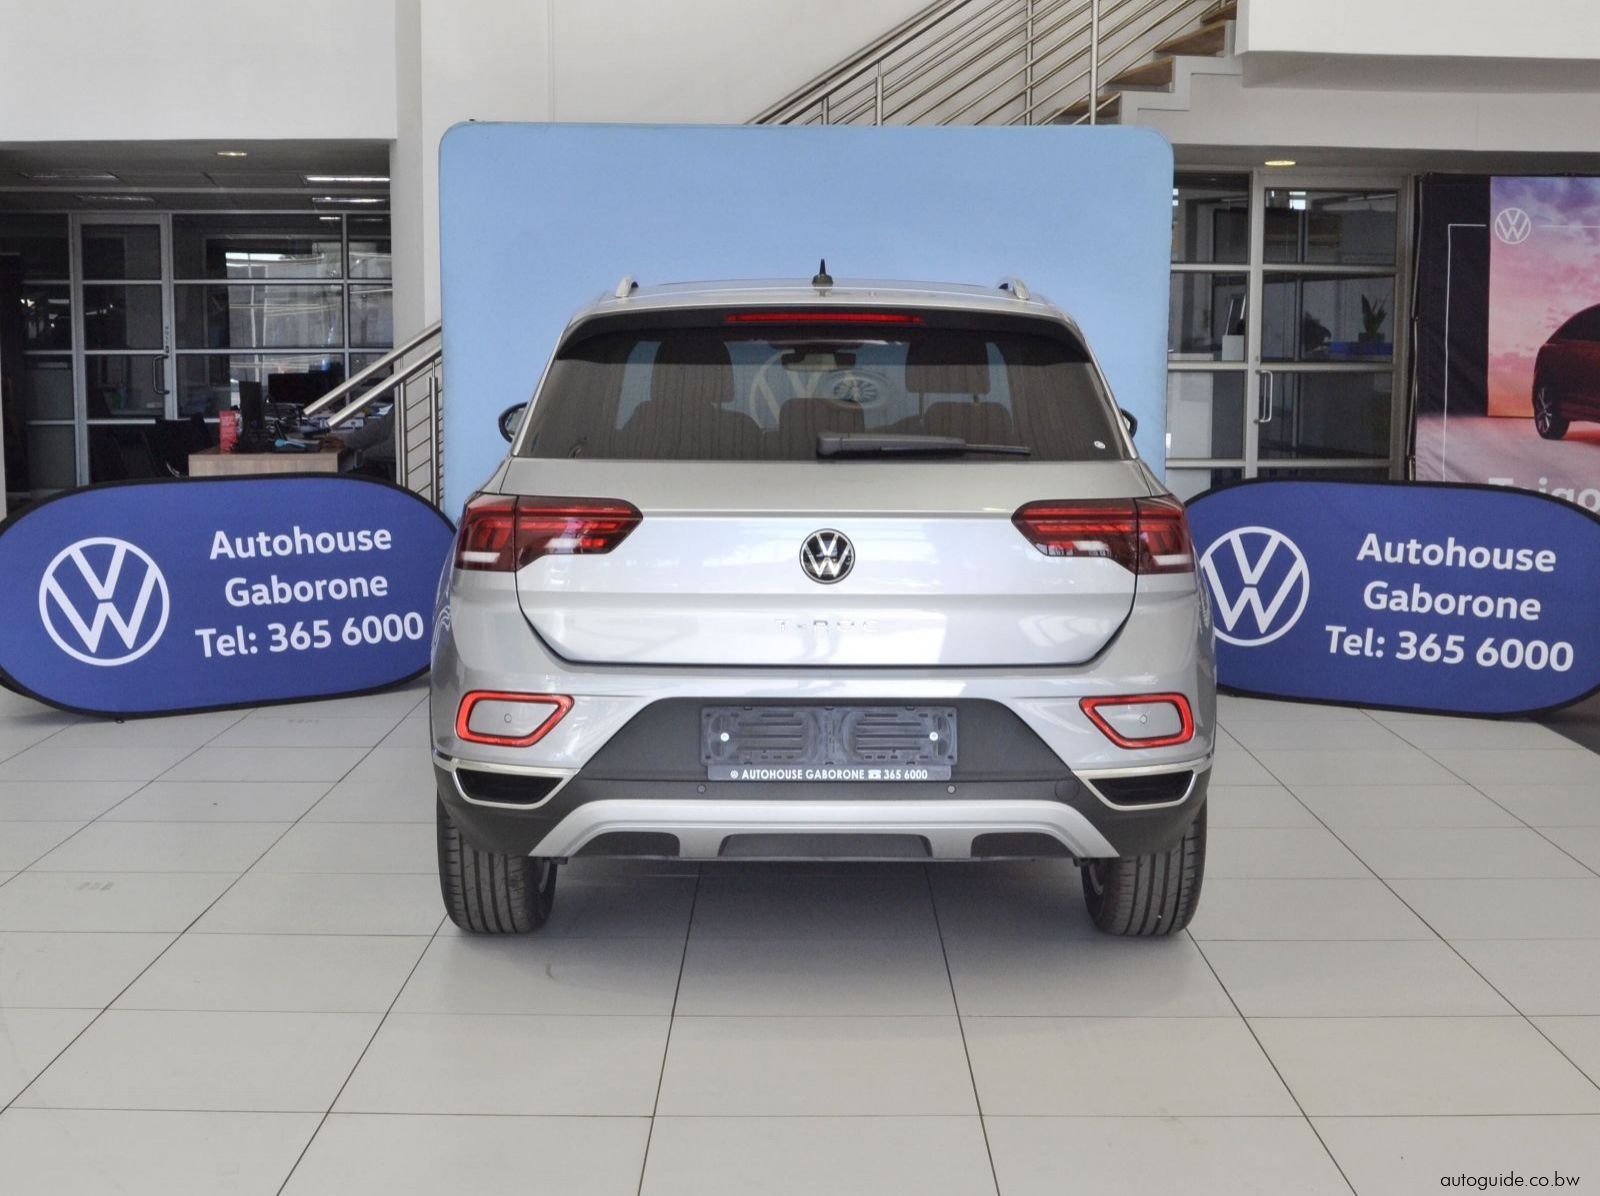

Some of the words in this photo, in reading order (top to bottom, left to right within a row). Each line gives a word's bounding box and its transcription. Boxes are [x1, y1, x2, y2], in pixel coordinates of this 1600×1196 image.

[210, 526, 391, 560] Autohouse
[1356, 533, 1557, 573] Autohouse
[225, 575, 388, 607] Gaborone
[1363, 580, 1541, 621] Gaborone
[195, 623, 258, 658] Tel:
[268, 619, 331, 653] 365
[342, 611, 424, 646] 6000
[1325, 625, 1385, 658] Tel:
[1395, 631, 1465, 665] 365
[1476, 638, 1574, 672] 6000
[741, 768, 803, 780] AUTOHOUSE
[805, 768, 865, 780] GABORONE
[883, 768, 902, 780] 365
[904, 768, 928, 780] 6000
